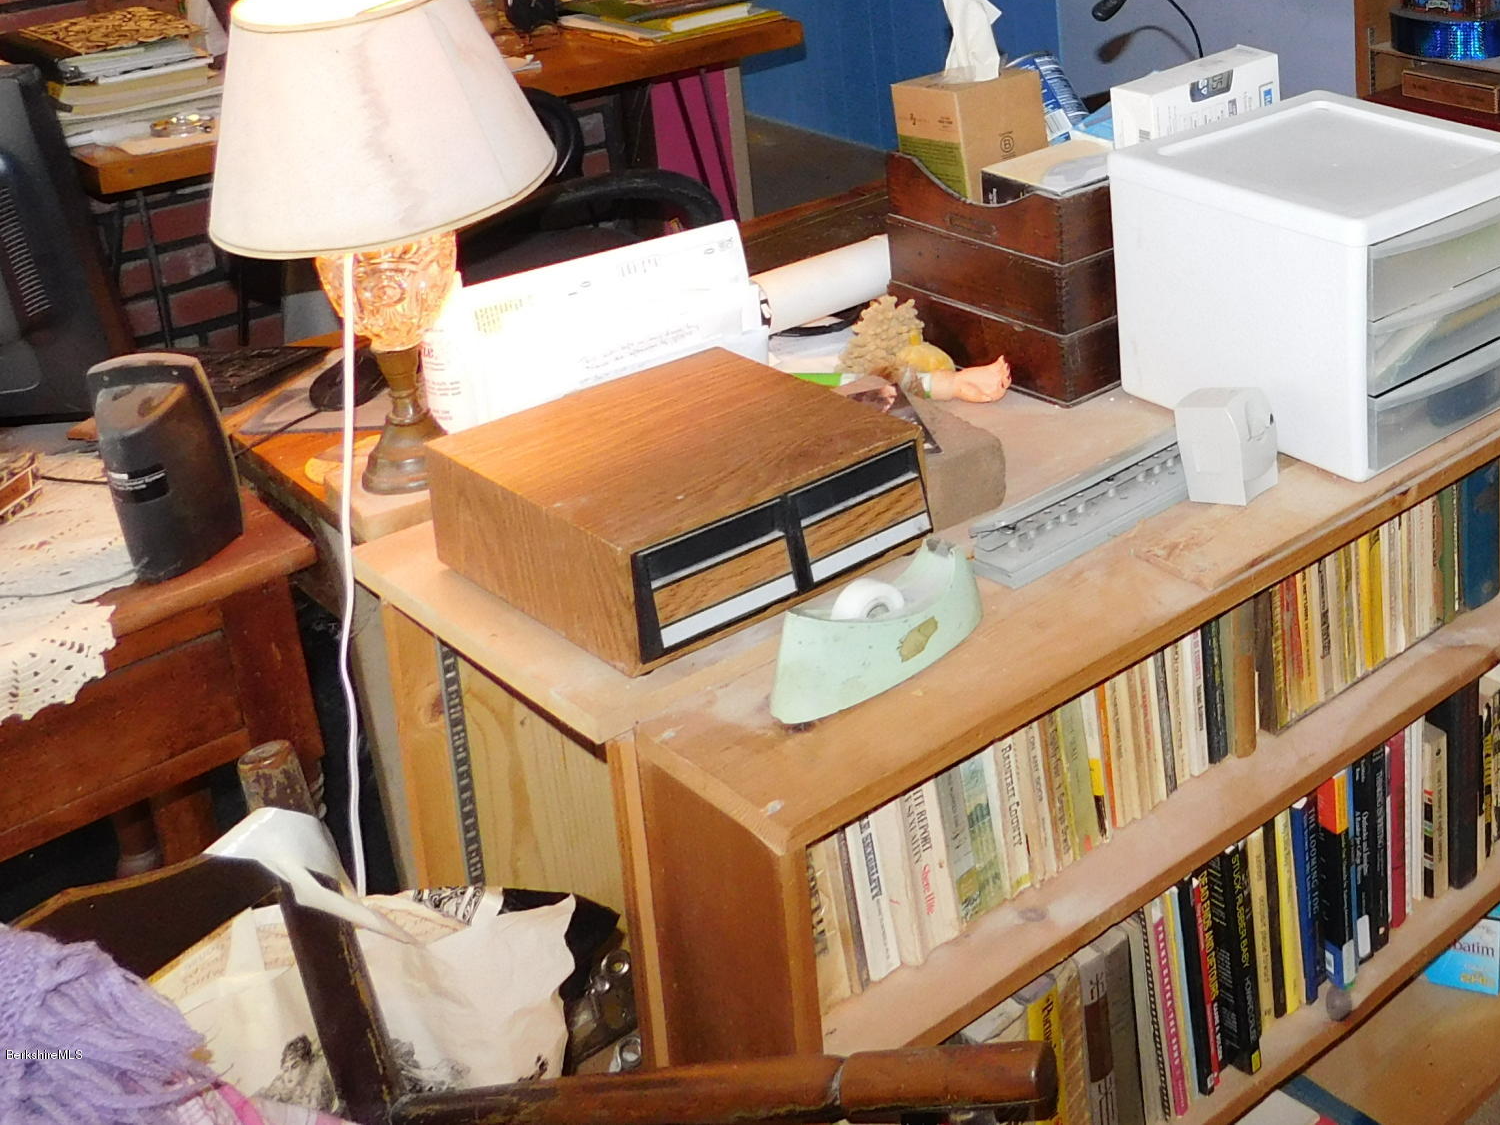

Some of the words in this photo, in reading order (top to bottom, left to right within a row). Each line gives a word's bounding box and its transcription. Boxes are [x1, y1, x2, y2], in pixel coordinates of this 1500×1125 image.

[916, 810, 932, 853] REPORT
[1008, 801, 1023, 847] COUNTY
[1307, 807, 1316, 831] THE
[1231, 854, 1243, 893] STUCK
[1309, 833, 1319, 888] LOOMING
[1198, 871, 1210, 901] DEAD
[1201, 901, 1213, 929] ENDS
[1235, 893, 1248, 940] RUBBER
[1158, 925, 1168, 965] FRANZ
[1204, 929, 1215, 954] AND
[1240, 940, 1250, 969] BABY
[1162, 968, 1173, 1006] KAFKA
[1207, 954, 1220, 1001] DETOURS
